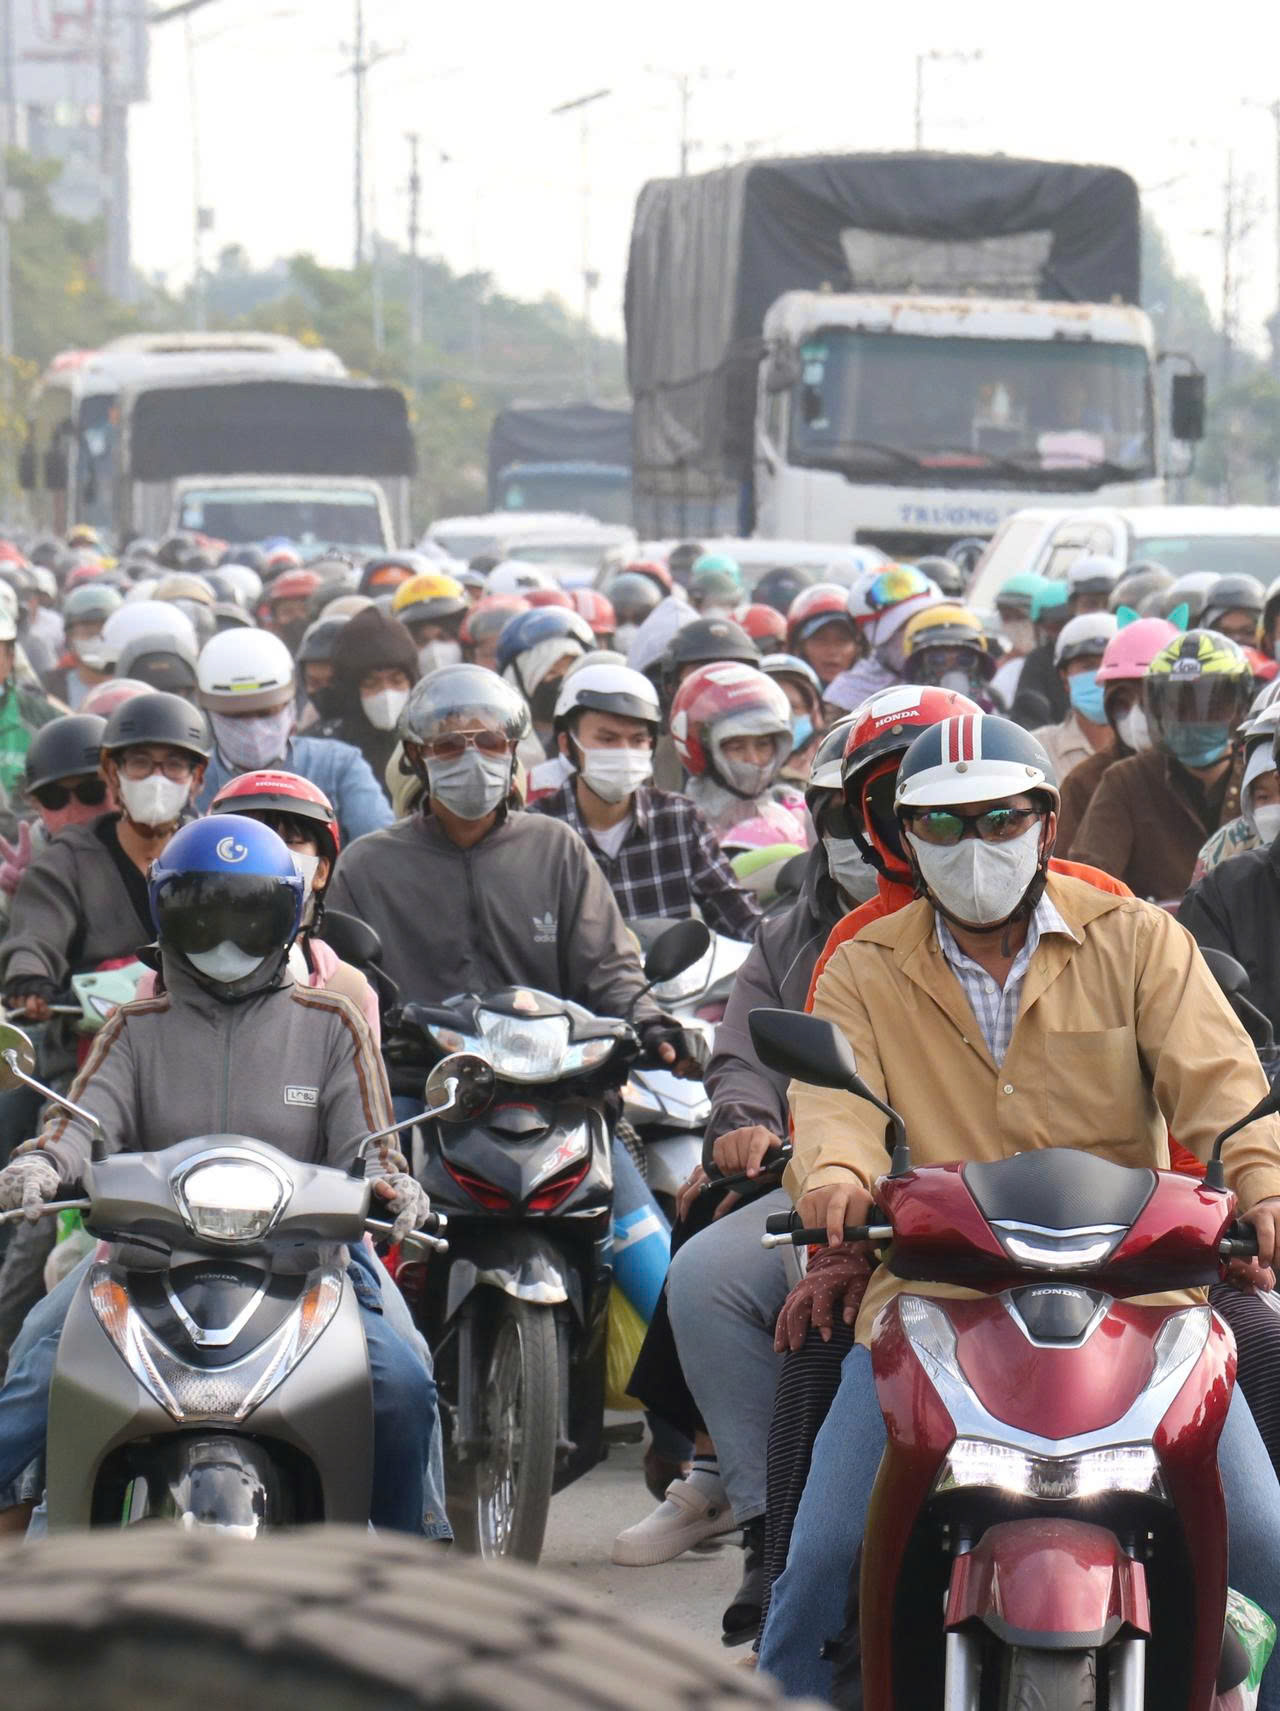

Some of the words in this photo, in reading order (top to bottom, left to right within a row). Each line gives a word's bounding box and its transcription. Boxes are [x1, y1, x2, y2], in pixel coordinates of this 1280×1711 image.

[874, 710, 920, 728] HONDA
[255, 781, 297, 790] HONDA
[194, 1273, 239, 1281] HONDA
[1031, 1288, 1082, 1299] HONDA
